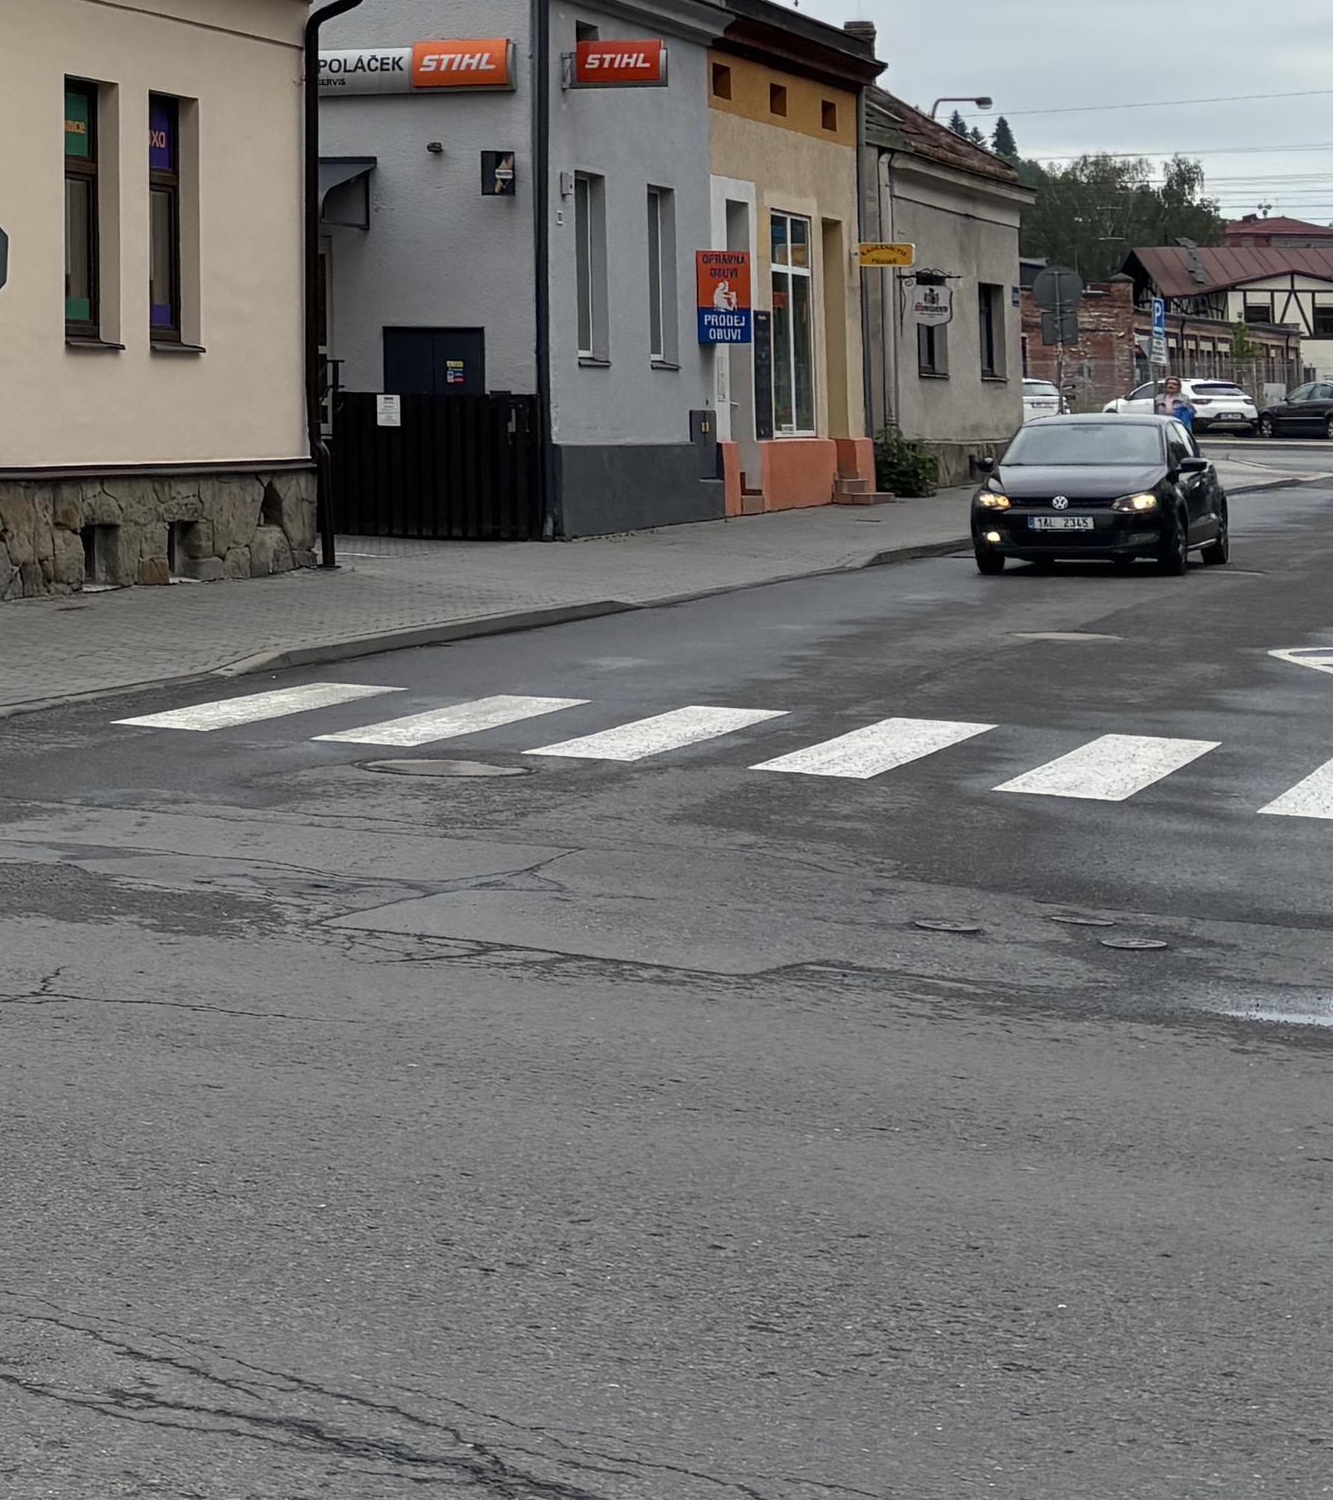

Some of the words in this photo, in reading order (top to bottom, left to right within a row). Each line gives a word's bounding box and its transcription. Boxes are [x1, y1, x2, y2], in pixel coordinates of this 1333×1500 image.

[318, 55, 404, 74] POLÁČEK
[419, 52, 496, 72] STIHL
[584, 53, 651, 69] STIHL
[704, 313, 746, 327] PRODEJ
[708, 328, 741, 340] OBUVI
